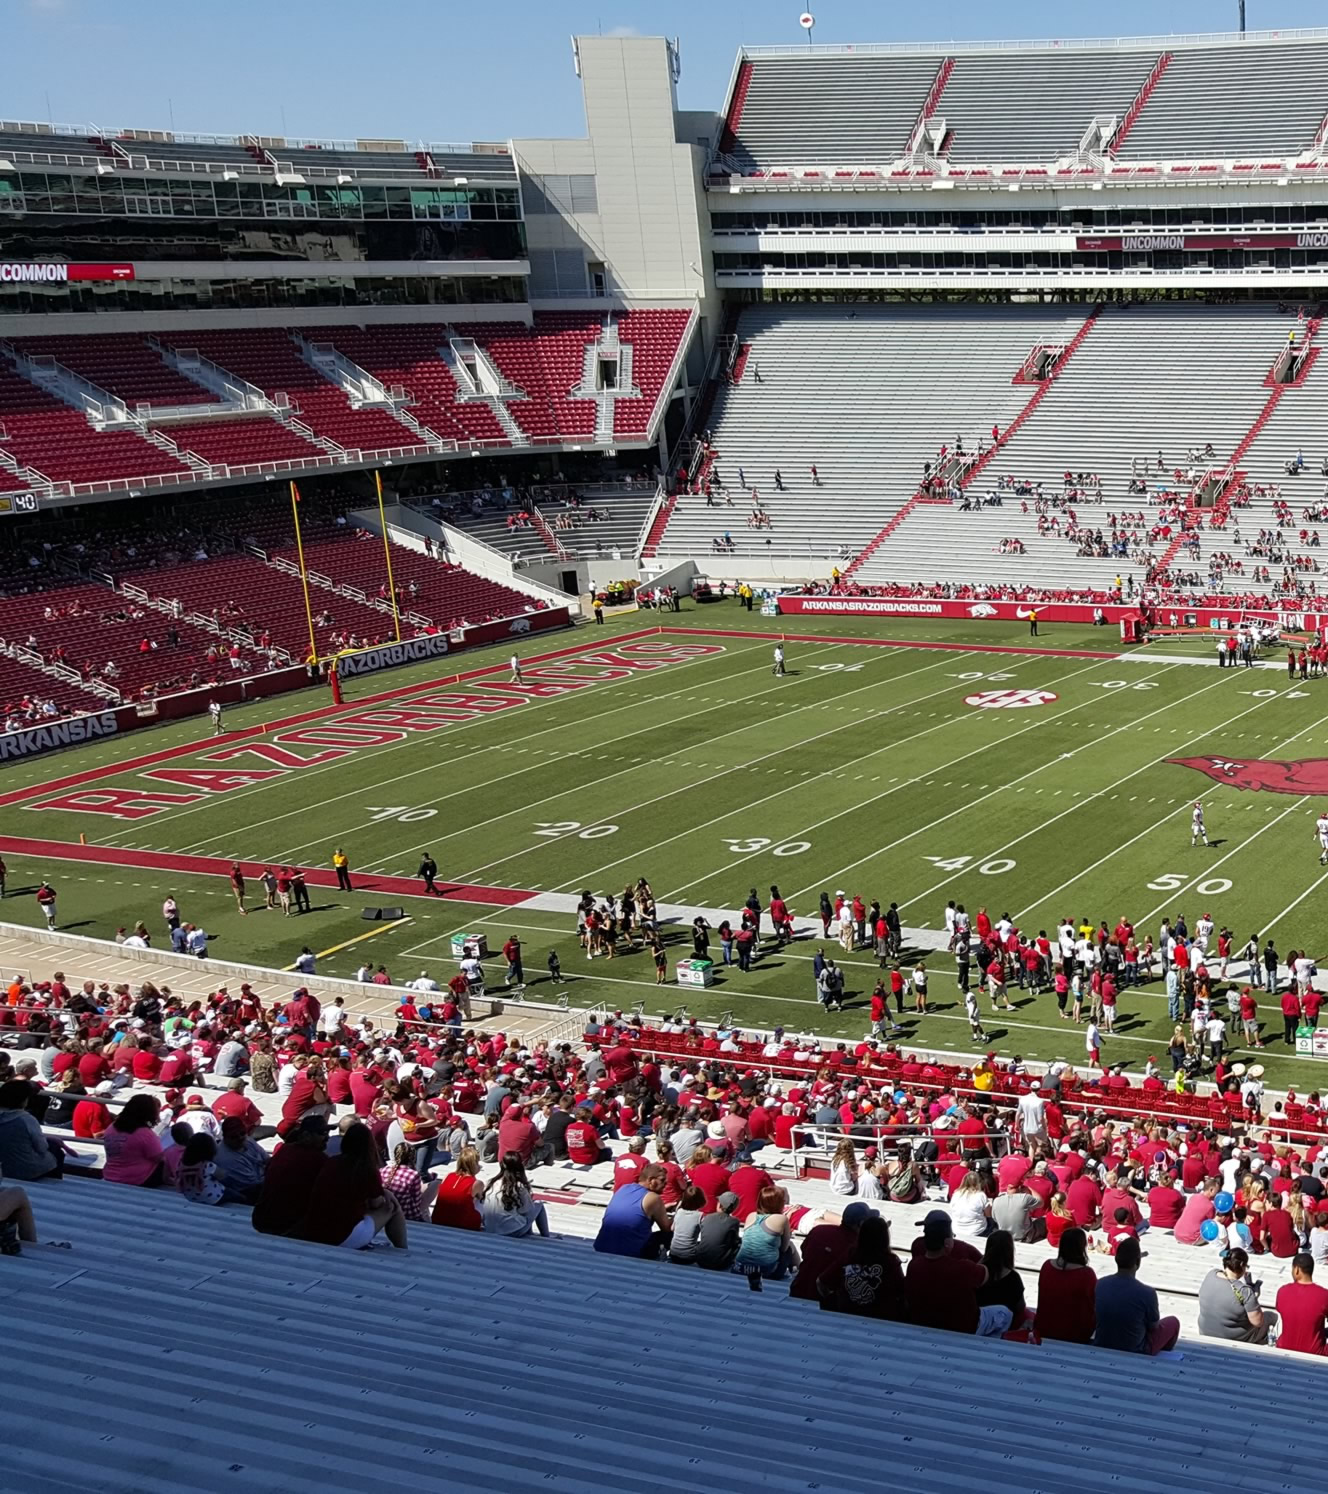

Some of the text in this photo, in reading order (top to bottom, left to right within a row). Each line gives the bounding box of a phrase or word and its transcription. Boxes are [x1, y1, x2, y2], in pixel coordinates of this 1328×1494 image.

[1121, 235, 1185, 250] UNCOMMON
[0, 263, 67, 281] COMMON
[15, 494, 36, 510] 40
[802, 601, 942, 613] ARKANSASRAZORBACKS.COM
[334, 636, 449, 676] RAZORBACKS
[815, 662, 866, 672] 10
[957, 671, 1019, 681] 20
[1101, 680, 1159, 690] 30
[0, 712, 118, 759] RKANSAS
[22, 642, 728, 820] RAZORBACKS
[366, 806, 439, 822] 10
[532, 821, 620, 839] 20
[729, 837, 813, 857] 30
[931, 855, 1016, 875] 40
[1146, 873, 1233, 895] 50
[454, 1090, 462, 1103] 7
